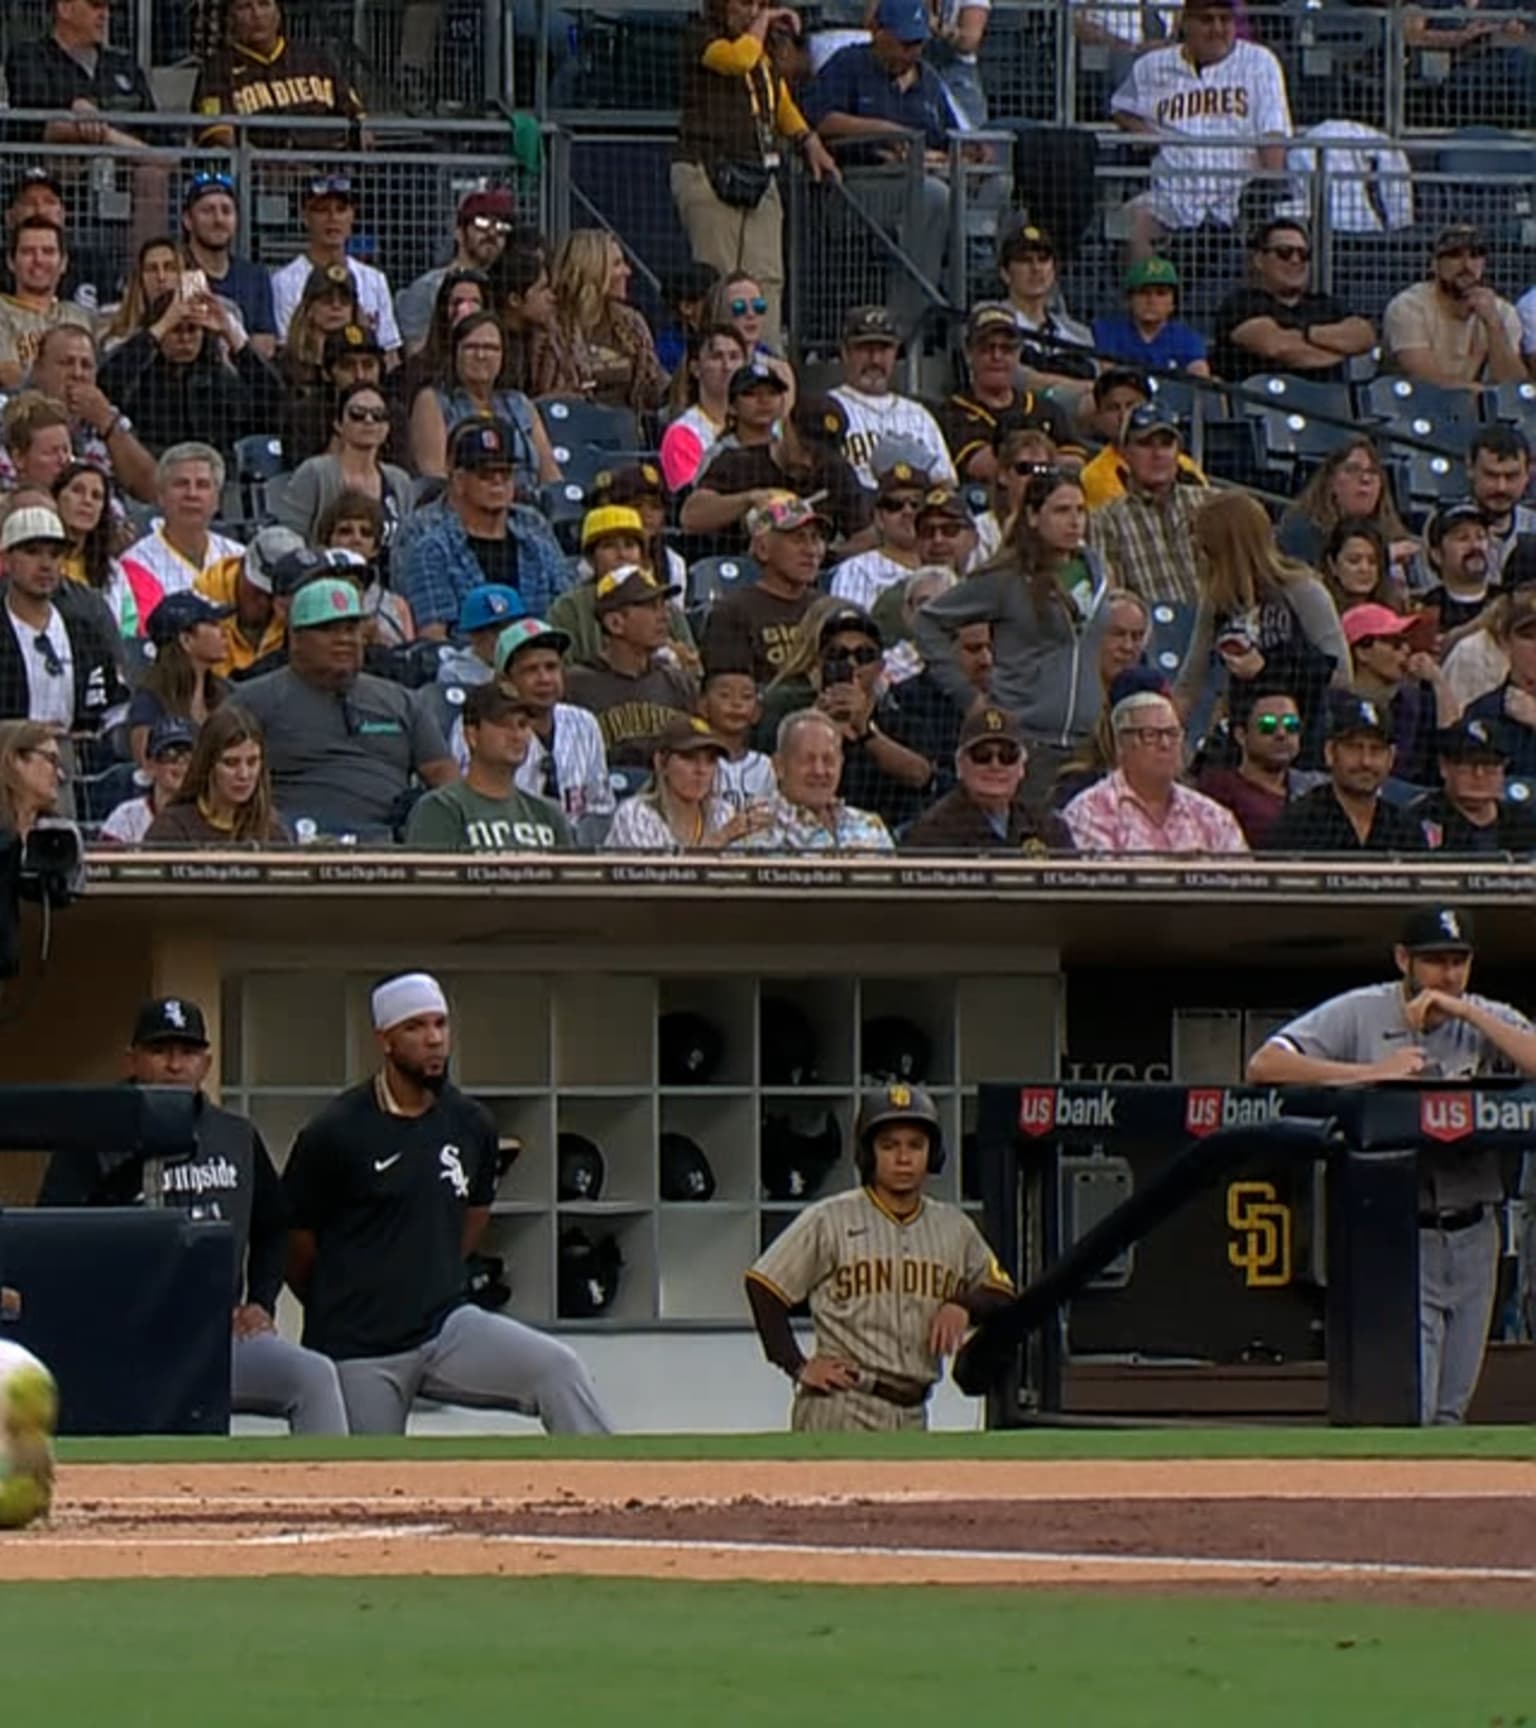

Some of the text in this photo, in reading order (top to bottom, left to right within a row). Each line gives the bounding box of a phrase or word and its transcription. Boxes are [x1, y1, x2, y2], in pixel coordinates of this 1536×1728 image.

[1156, 85, 1250, 126] PADRES
[1055, 1087, 1116, 1127] bank
[1222, 1088, 1285, 1127] bank
[1476, 1090, 1536, 1131] ban
[835, 1257, 893, 1301] SAN
